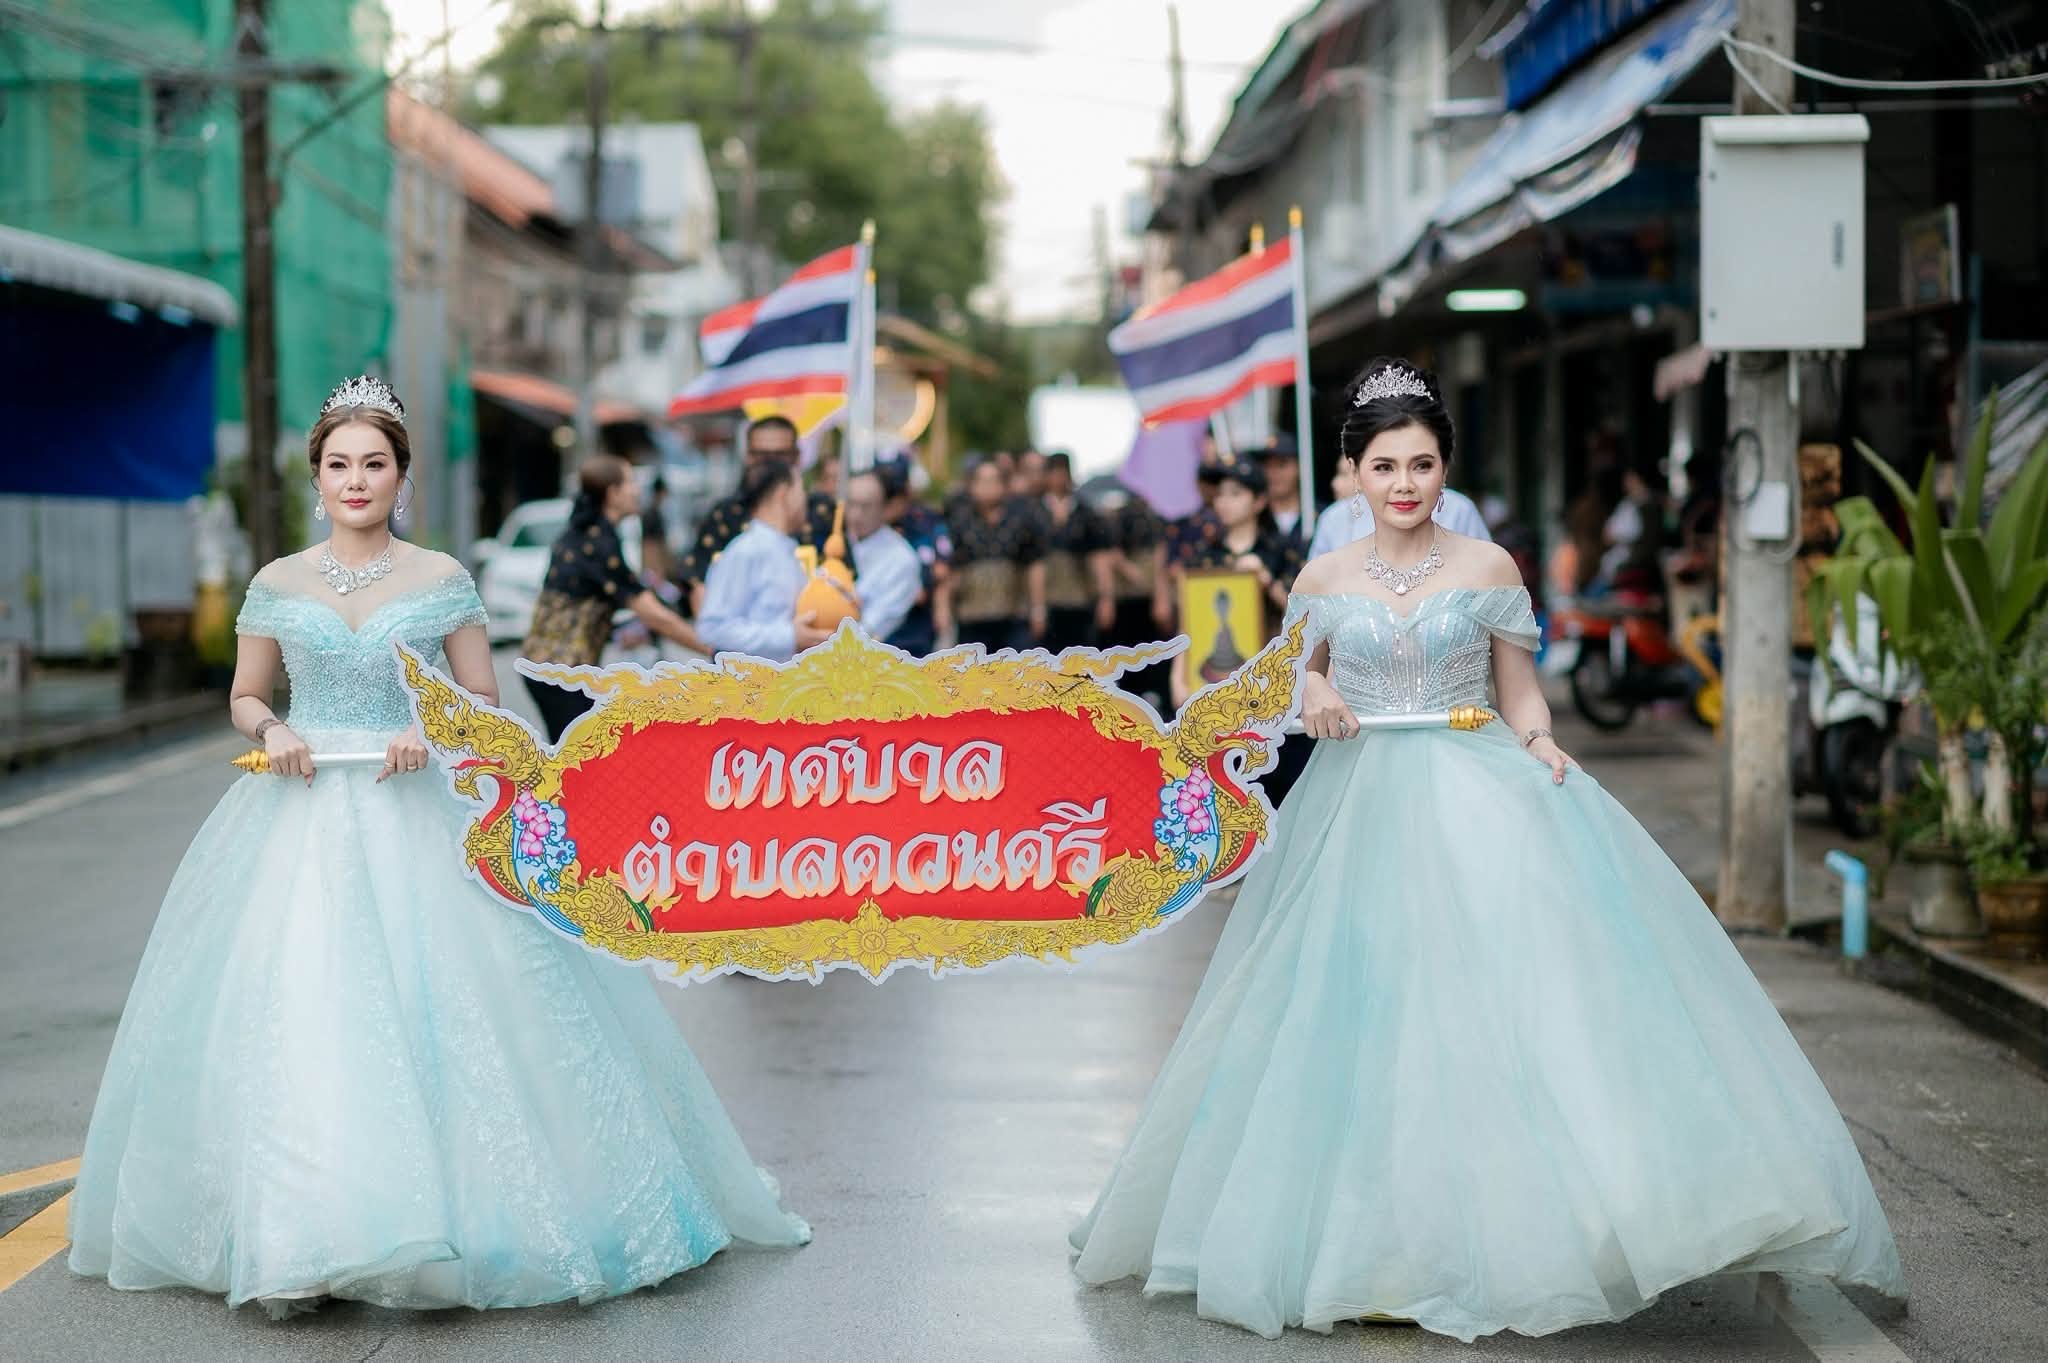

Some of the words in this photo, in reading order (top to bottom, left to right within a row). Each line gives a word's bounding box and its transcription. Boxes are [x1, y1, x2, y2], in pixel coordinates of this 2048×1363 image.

[706, 737, 1004, 809] เทศบาล
[621, 798, 1109, 901] ตำบลควนศรี
